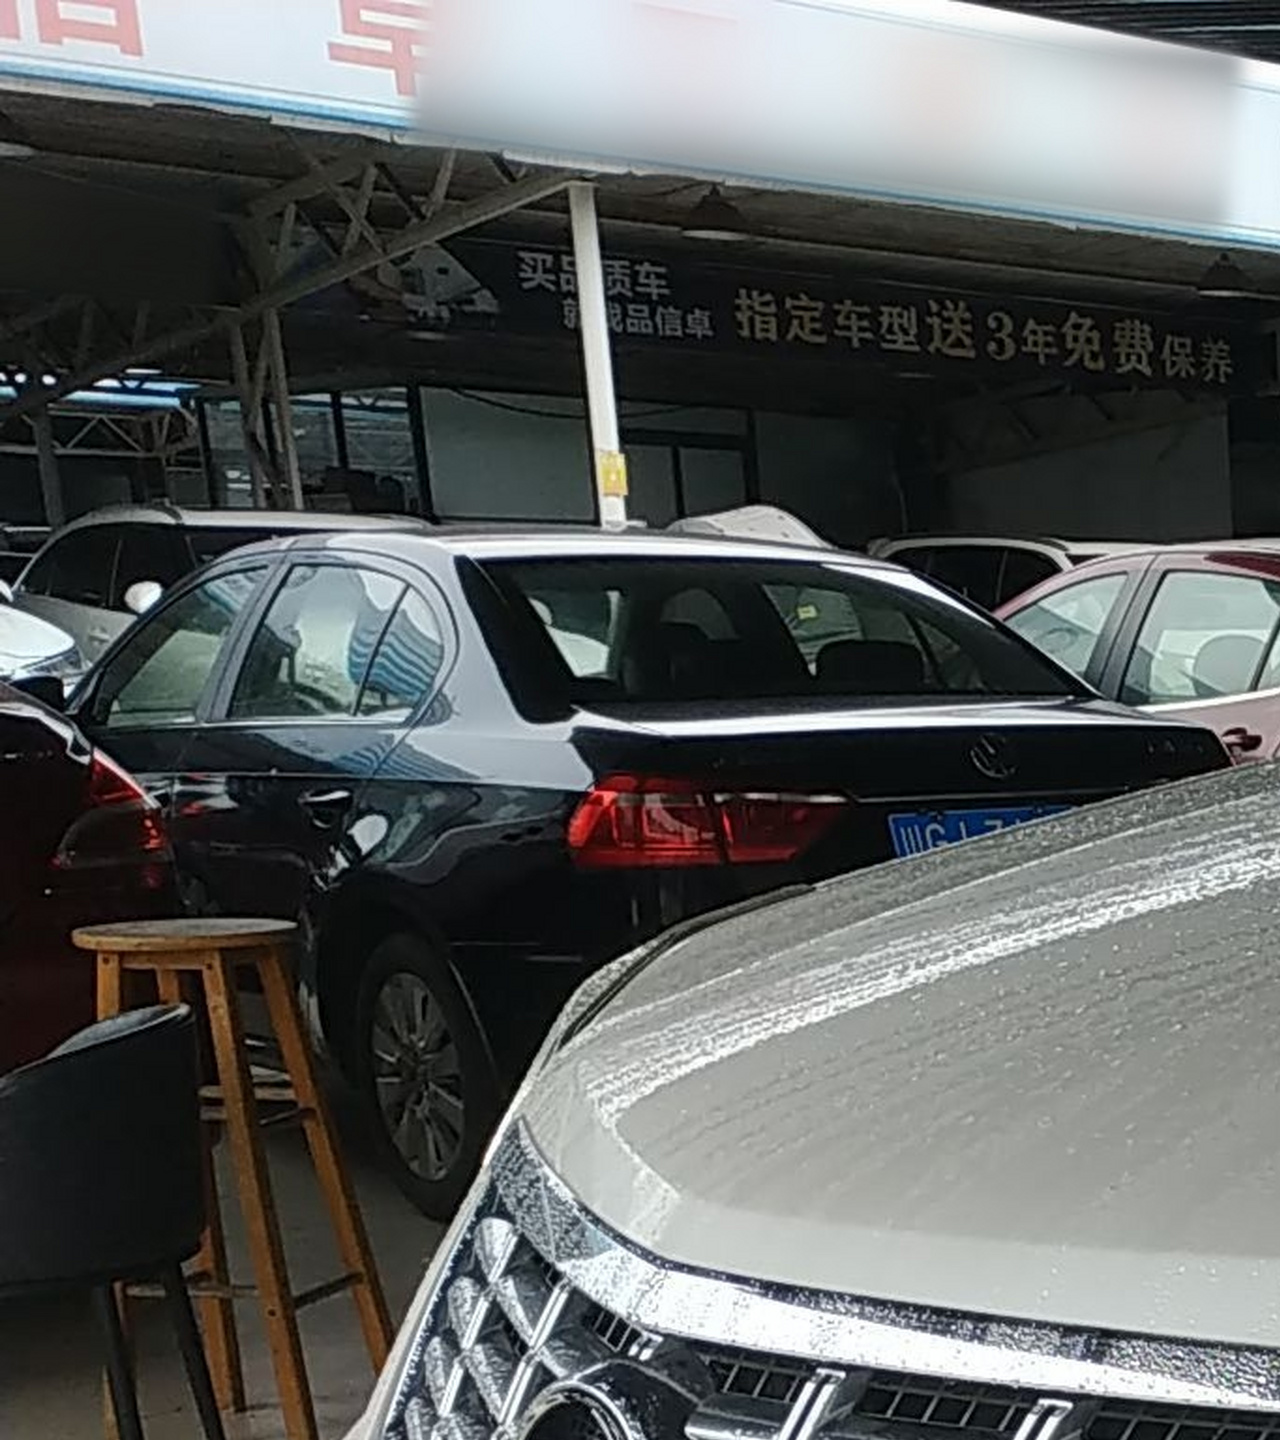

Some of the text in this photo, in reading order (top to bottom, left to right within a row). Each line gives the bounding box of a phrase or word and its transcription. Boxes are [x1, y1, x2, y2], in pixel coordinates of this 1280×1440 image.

[735, 288, 1234, 384] 指定车型送3年免费保养
